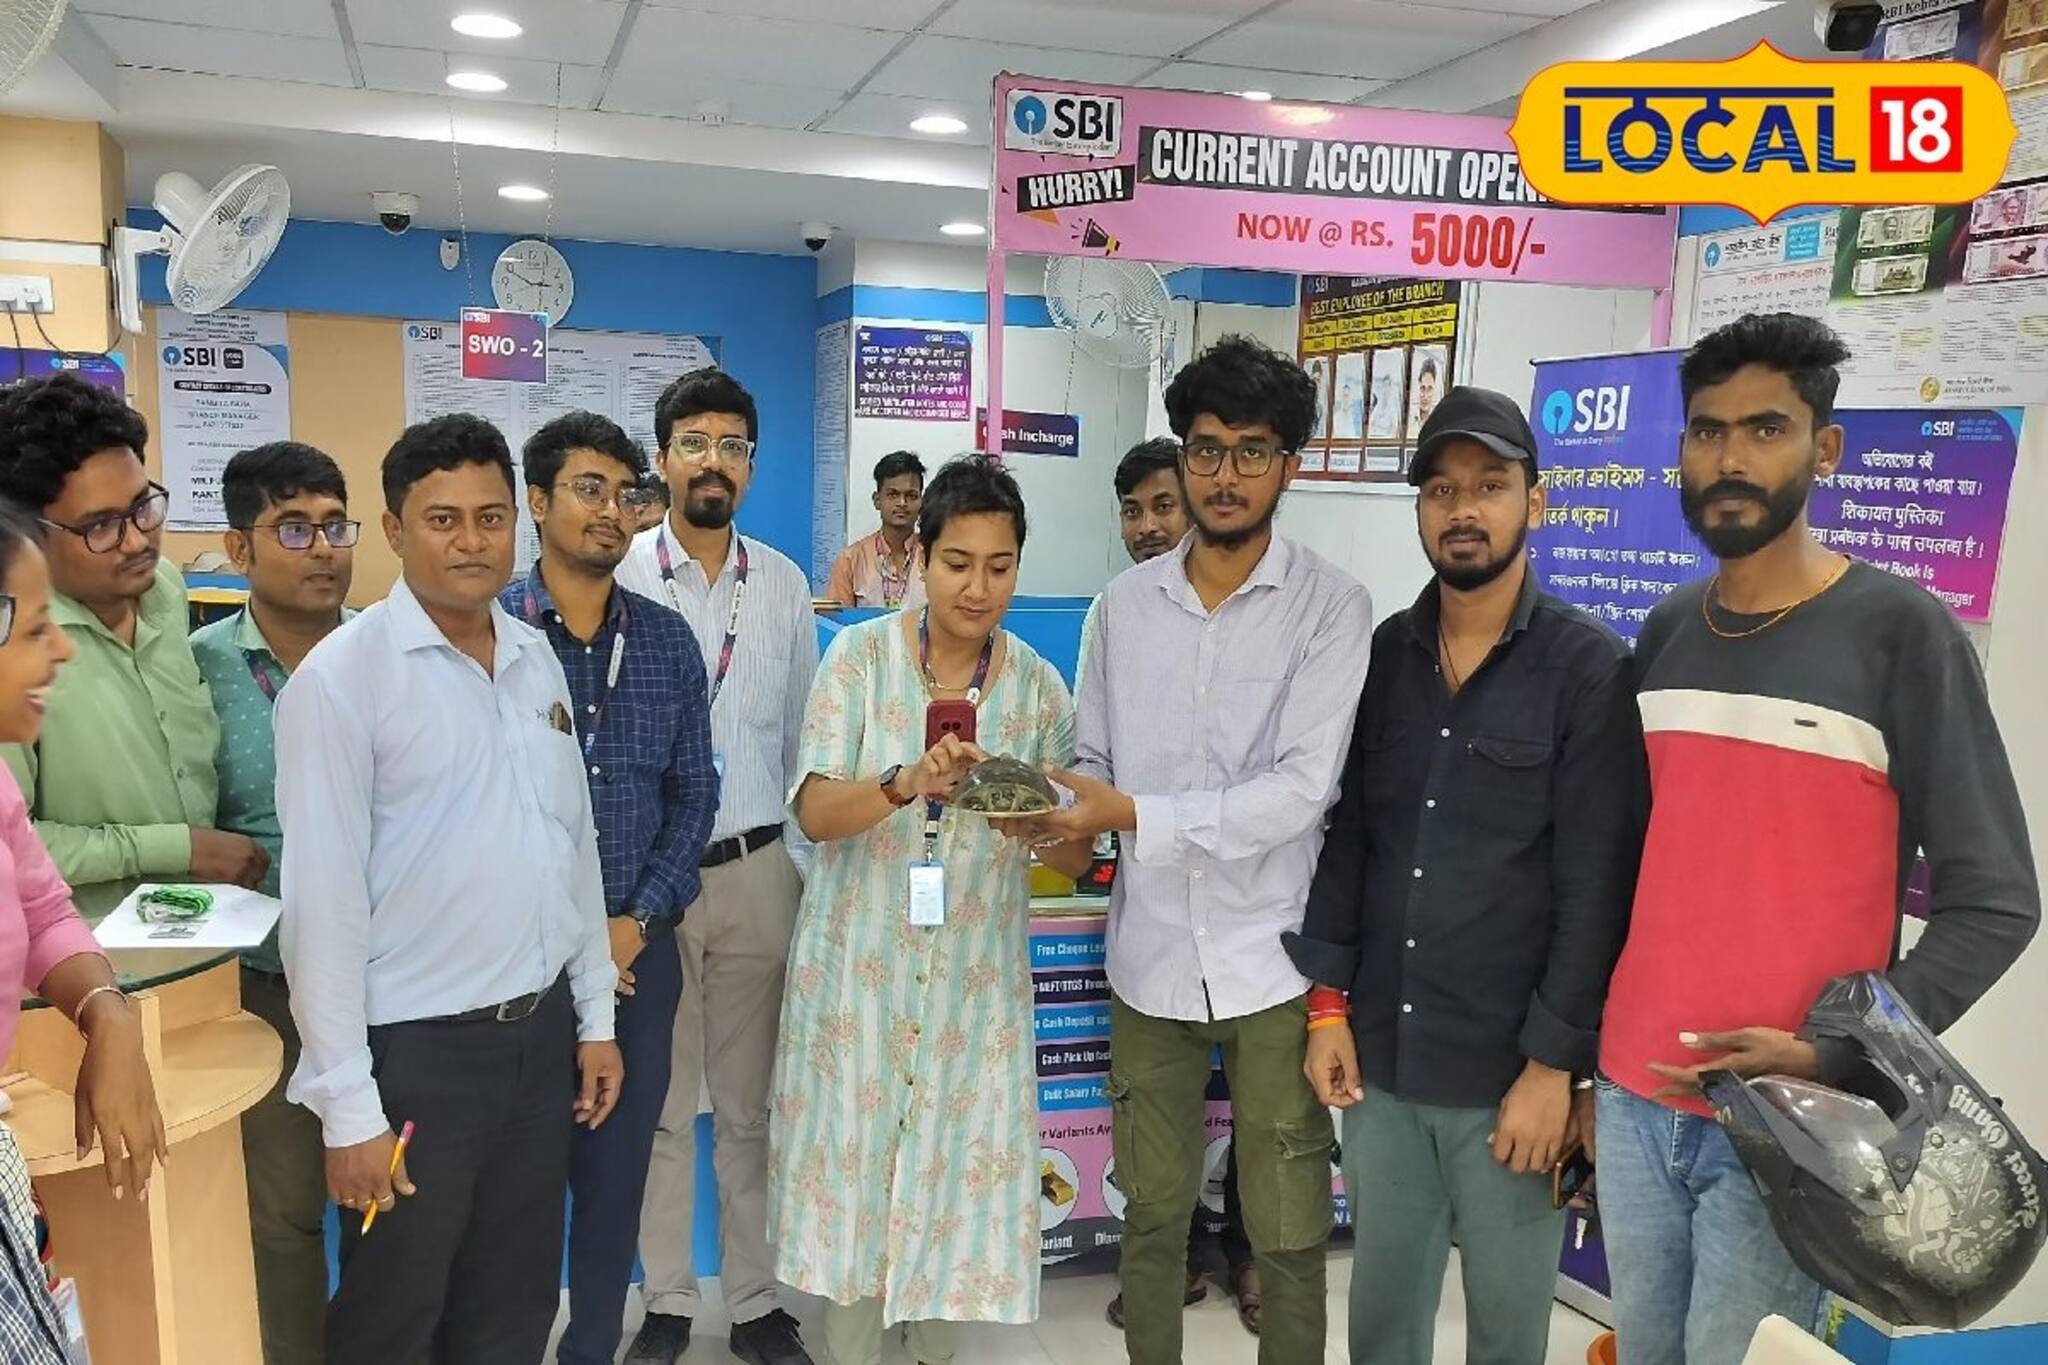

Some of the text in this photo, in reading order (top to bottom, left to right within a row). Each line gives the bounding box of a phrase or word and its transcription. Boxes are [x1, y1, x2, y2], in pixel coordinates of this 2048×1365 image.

[1053, 98, 1115, 142] SBI
[1151, 129, 1298, 187] CURRENT
[1305, 141, 1452, 197] ACCOUNT
[1028, 168, 1124, 208] HURRY!
[1237, 212, 1545, 275] NOW @ RS. 5000/-
[421, 326, 442, 341] SBI
[468, 334, 515, 356] SWO
[532, 339, 544, 357] 2
[184, 347, 215, 367] SBI
[1573, 385, 1631, 433] SBI
[1019, 428, 1074, 448] Incharge
[1933, 421, 1955, 436] SBI
[1841, 499, 1945, 529] शिकायत पुस्तिका
[1871, 527, 1884, 549] के
[1886, 534, 1913, 551] पास
[1890, 561, 1921, 578] Book
[1037, 944, 1055, 956] Free
[1058, 943, 1088, 955] Cheque
[1042, 1016, 1063, 1029] Cash
[1065, 1015, 1094, 1028] Deposit
[1042, 1053, 1062, 1066] Cash
[1064, 1052, 1082, 1064] Pick
[1083, 1050, 1094, 1063] Up
[1064, 1086, 1089, 1100] Salary
[1049, 1126, 1095, 1140] Variants
